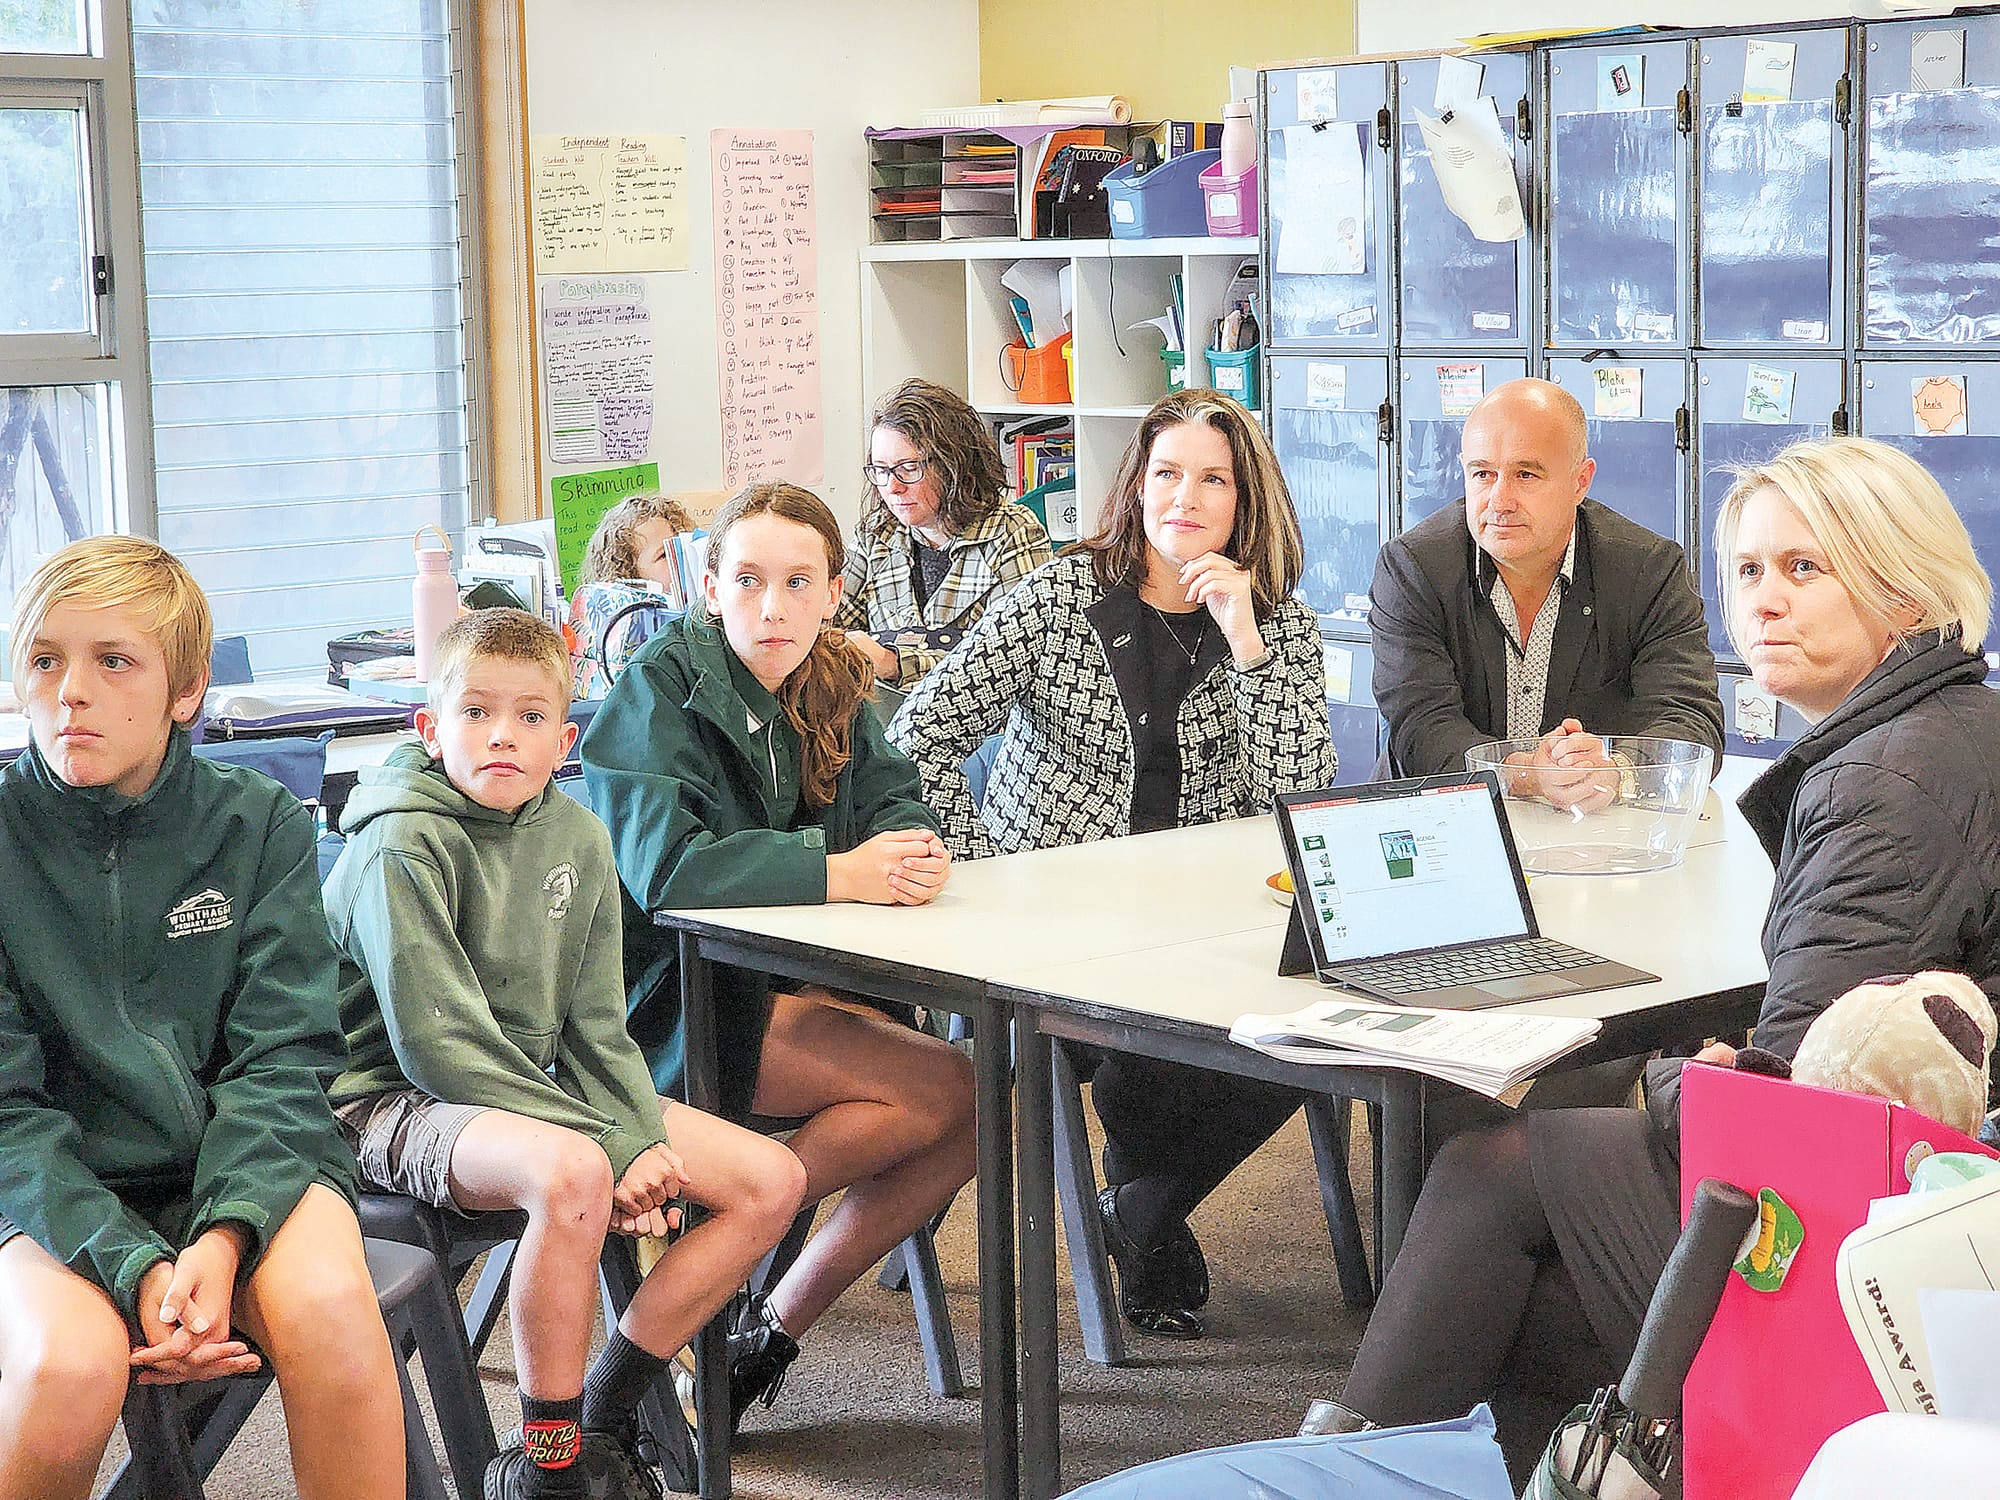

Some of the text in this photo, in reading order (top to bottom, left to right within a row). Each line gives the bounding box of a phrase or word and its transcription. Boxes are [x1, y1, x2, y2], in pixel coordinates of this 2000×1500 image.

[561, 137, 647, 154] Independent Reading
[731, 135, 776, 149] Annotations
[614, 154, 639, 163] Teachers
[1076, 150, 1121, 163] OXFORD
[741, 240, 751, 255] Key
[761, 237, 778, 248] words
[560, 280, 645, 304] Paraphrasing
[745, 302, 762, 313] Happy
[744, 315, 774, 329] Sad part
[1598, 369, 1625, 389] Blake
[740, 405, 756, 417] Funny
[558, 507, 596, 520] This is
[560, 521, 578, 535] read
[560, 540, 569, 551] to
[169, 903, 231, 925] WONTHAGGI
[1864, 1276, 1917, 1373] Award!
